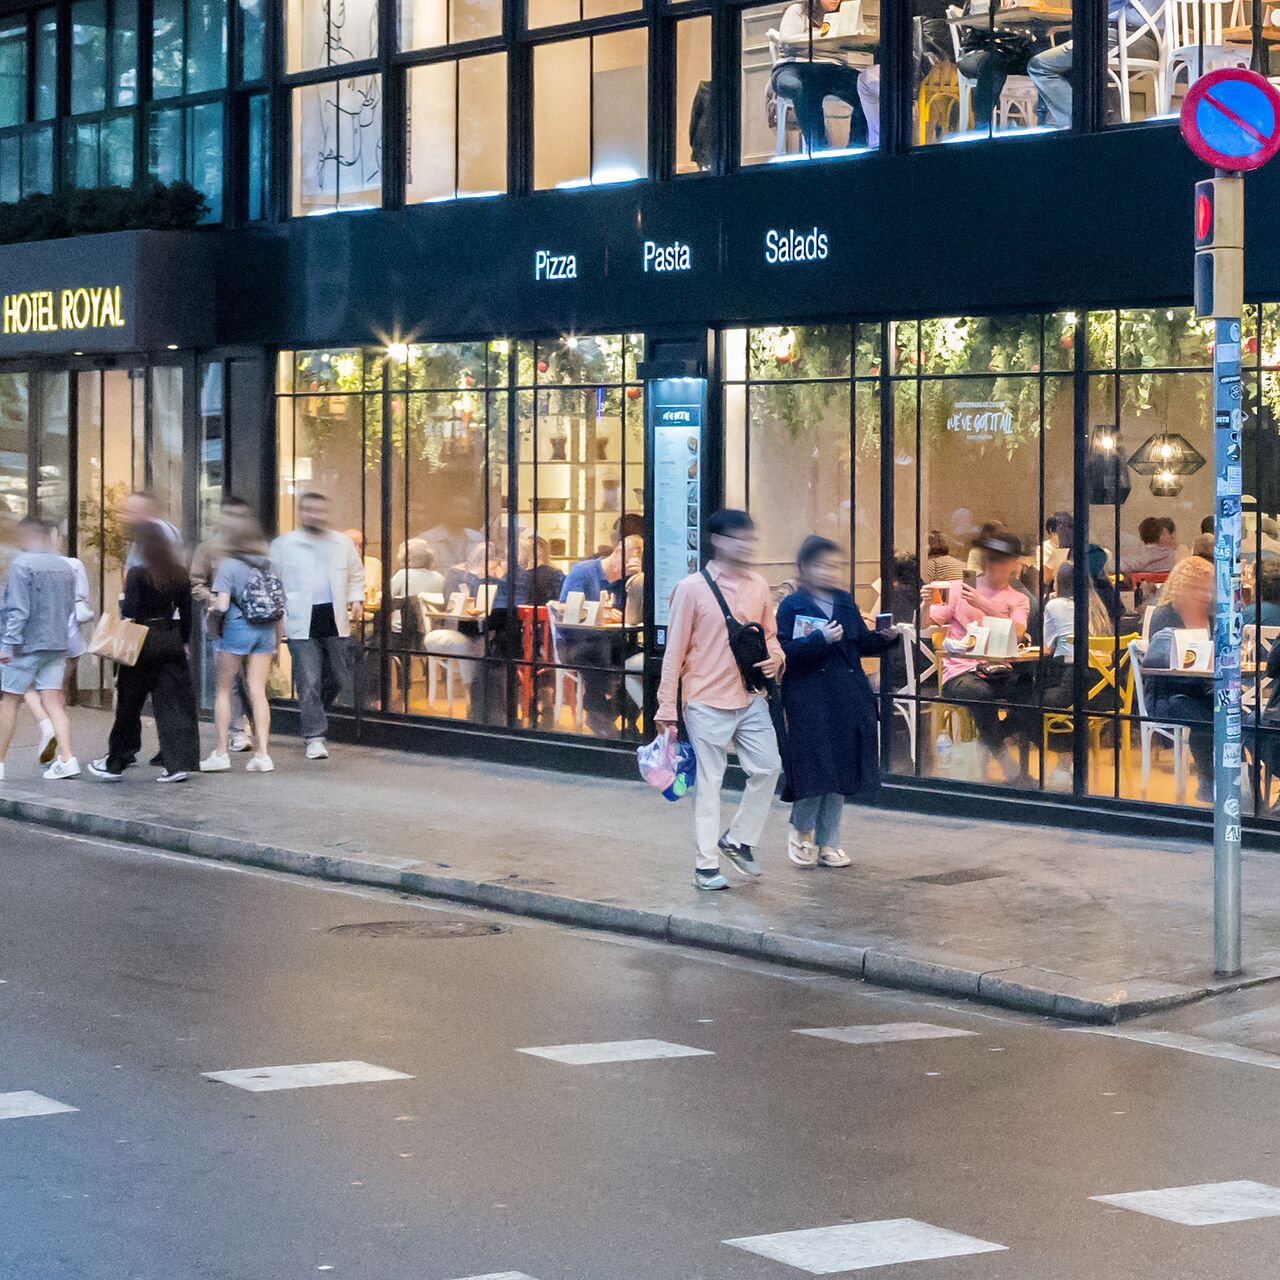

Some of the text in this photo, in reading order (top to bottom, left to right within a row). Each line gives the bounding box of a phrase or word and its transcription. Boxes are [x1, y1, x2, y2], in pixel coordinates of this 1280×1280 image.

[535, 226, 829, 281] Pizza Pasta Salads
[3, 284, 126, 334] HOTEL ROYAL
